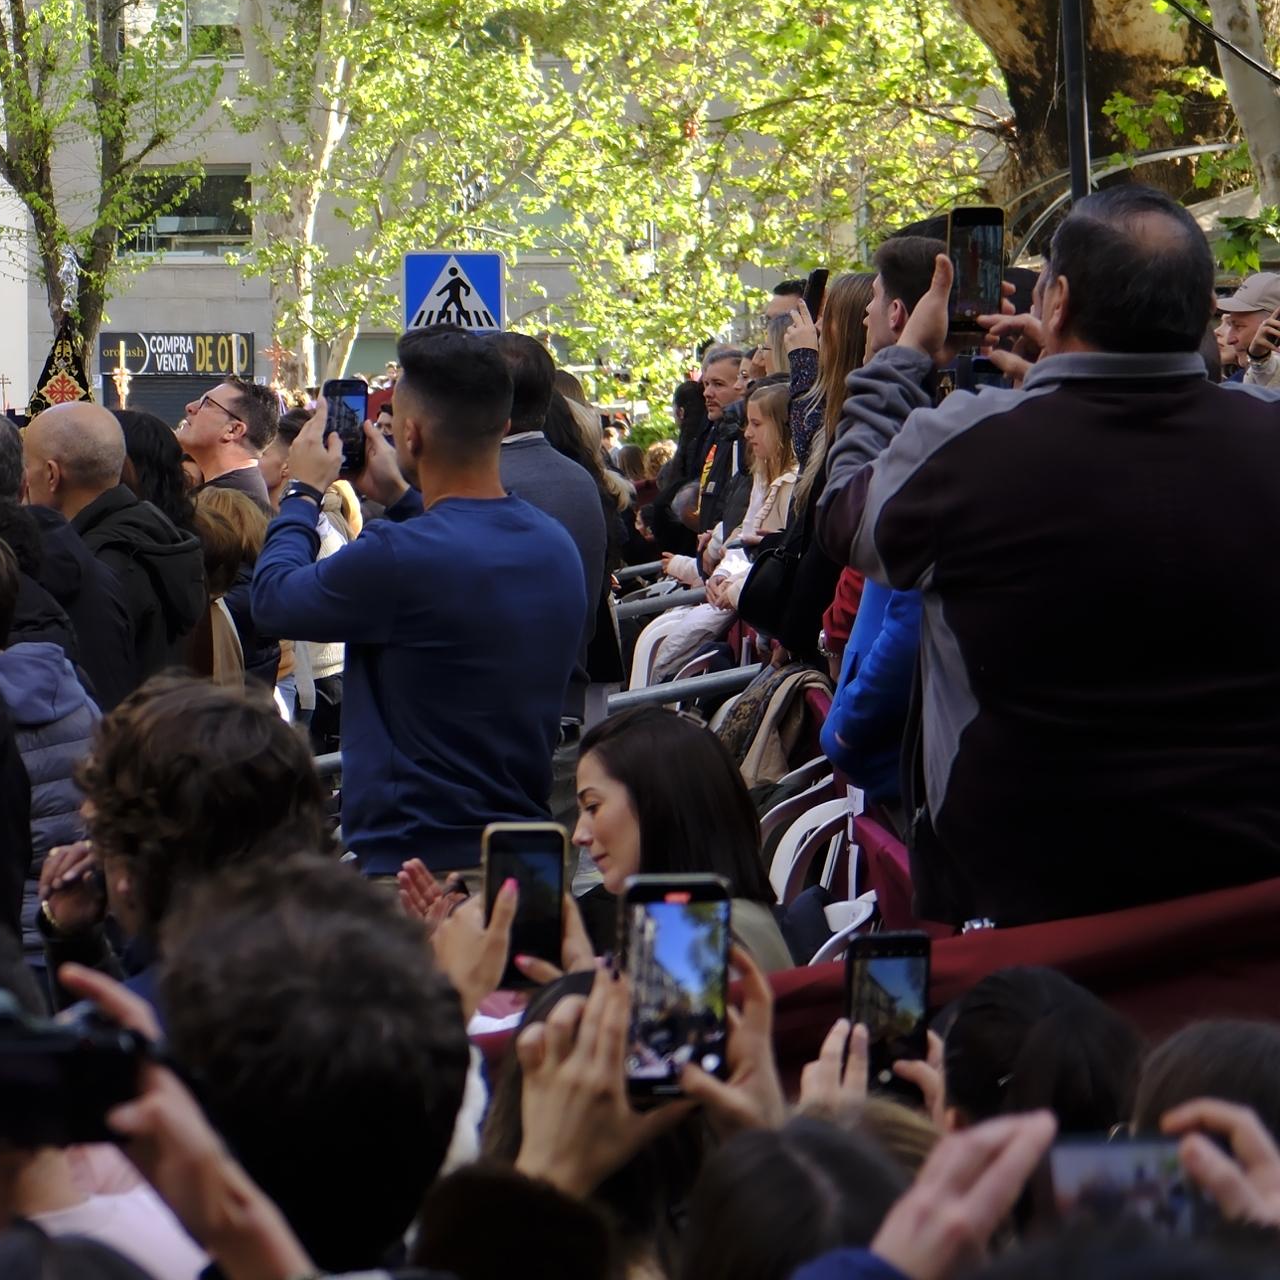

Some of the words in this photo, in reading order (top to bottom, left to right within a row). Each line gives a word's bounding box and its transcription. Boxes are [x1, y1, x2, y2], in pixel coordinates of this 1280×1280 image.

[102, 346, 144, 358] oroash
[150, 335, 193, 354] COMPRA
[195, 335, 214, 372] DE
[218, 335, 248, 373] OO
[156, 354, 188, 371] VENTA
